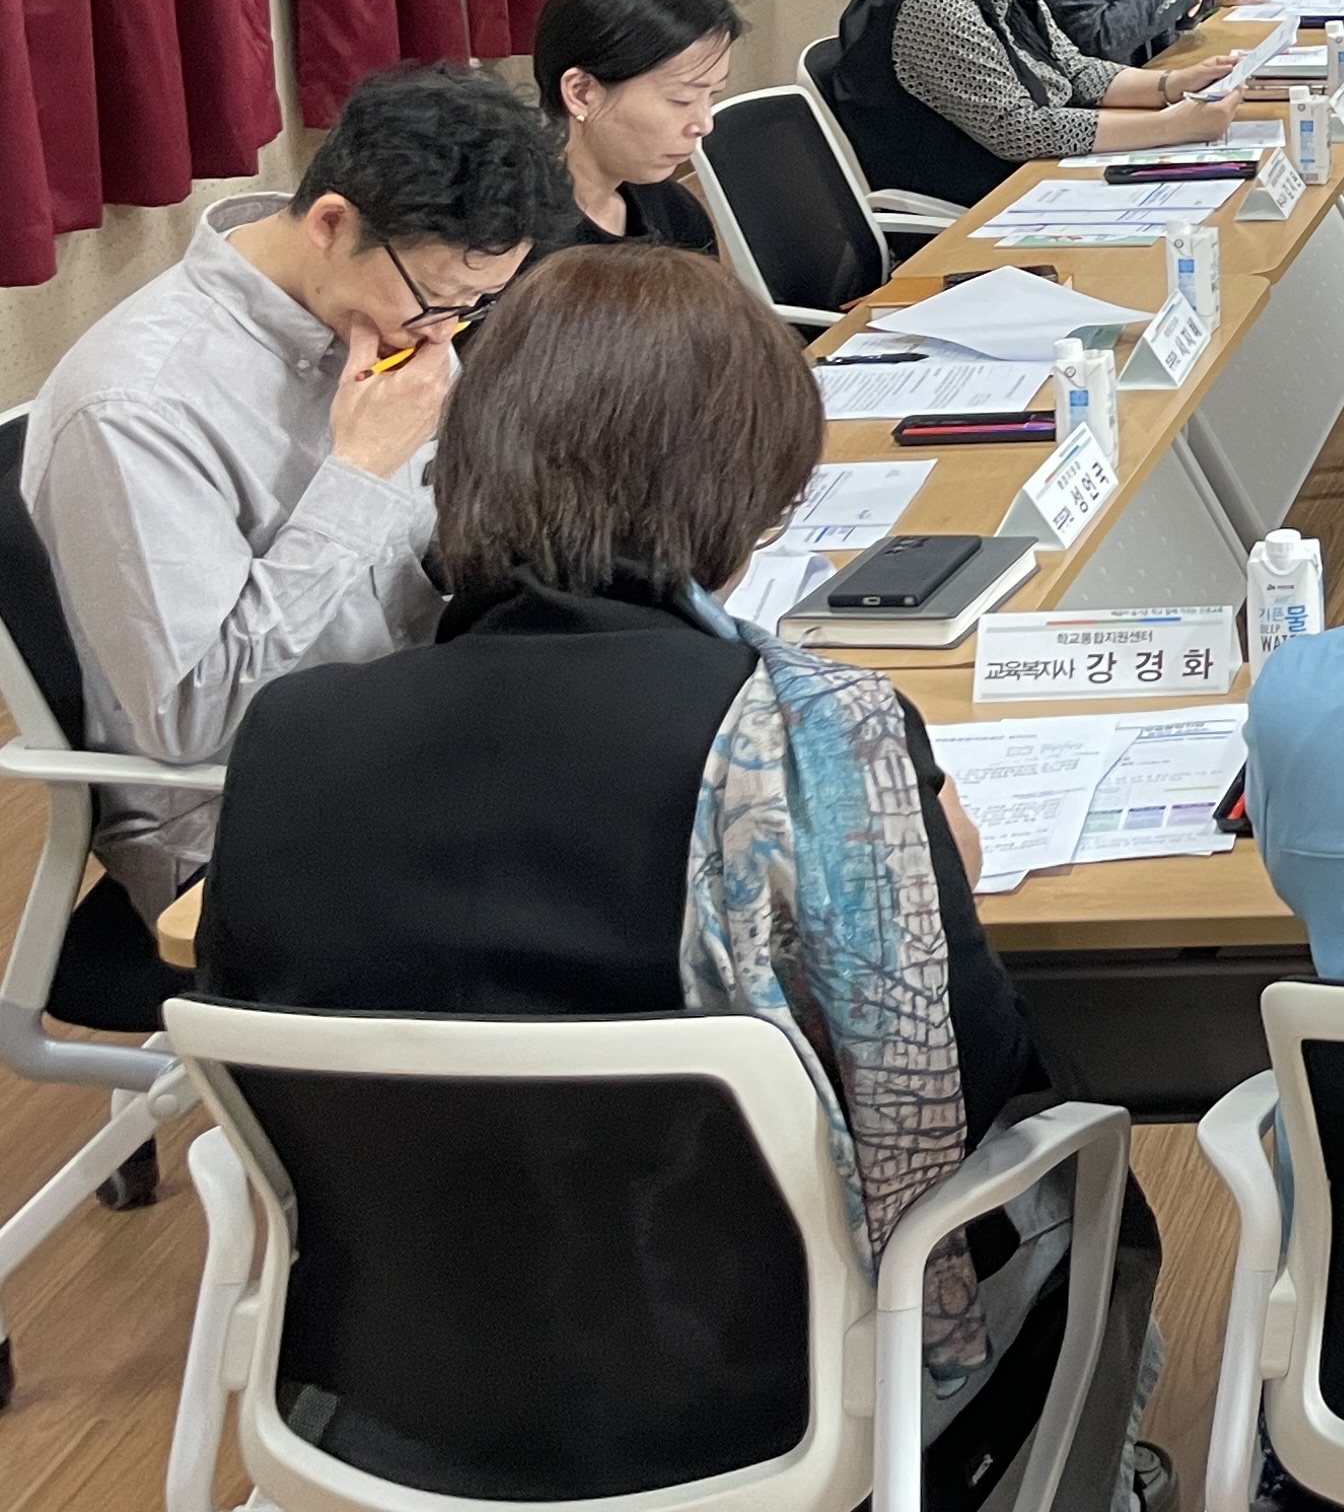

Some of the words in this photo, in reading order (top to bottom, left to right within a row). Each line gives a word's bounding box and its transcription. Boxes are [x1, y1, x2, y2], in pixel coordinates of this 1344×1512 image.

[1285, 604, 1308, 633] 물
[1057, 630, 1153, 645] 학교통합지원센터
[1260, 624, 1281, 634] DEEP
[1261, 635, 1297, 652] WAT
[984, 658, 1076, 681] 교육복지사
[1086, 652, 1117, 684] 강
[1135, 649, 1163, 683] 경
[1181, 647, 1214, 680] 화
